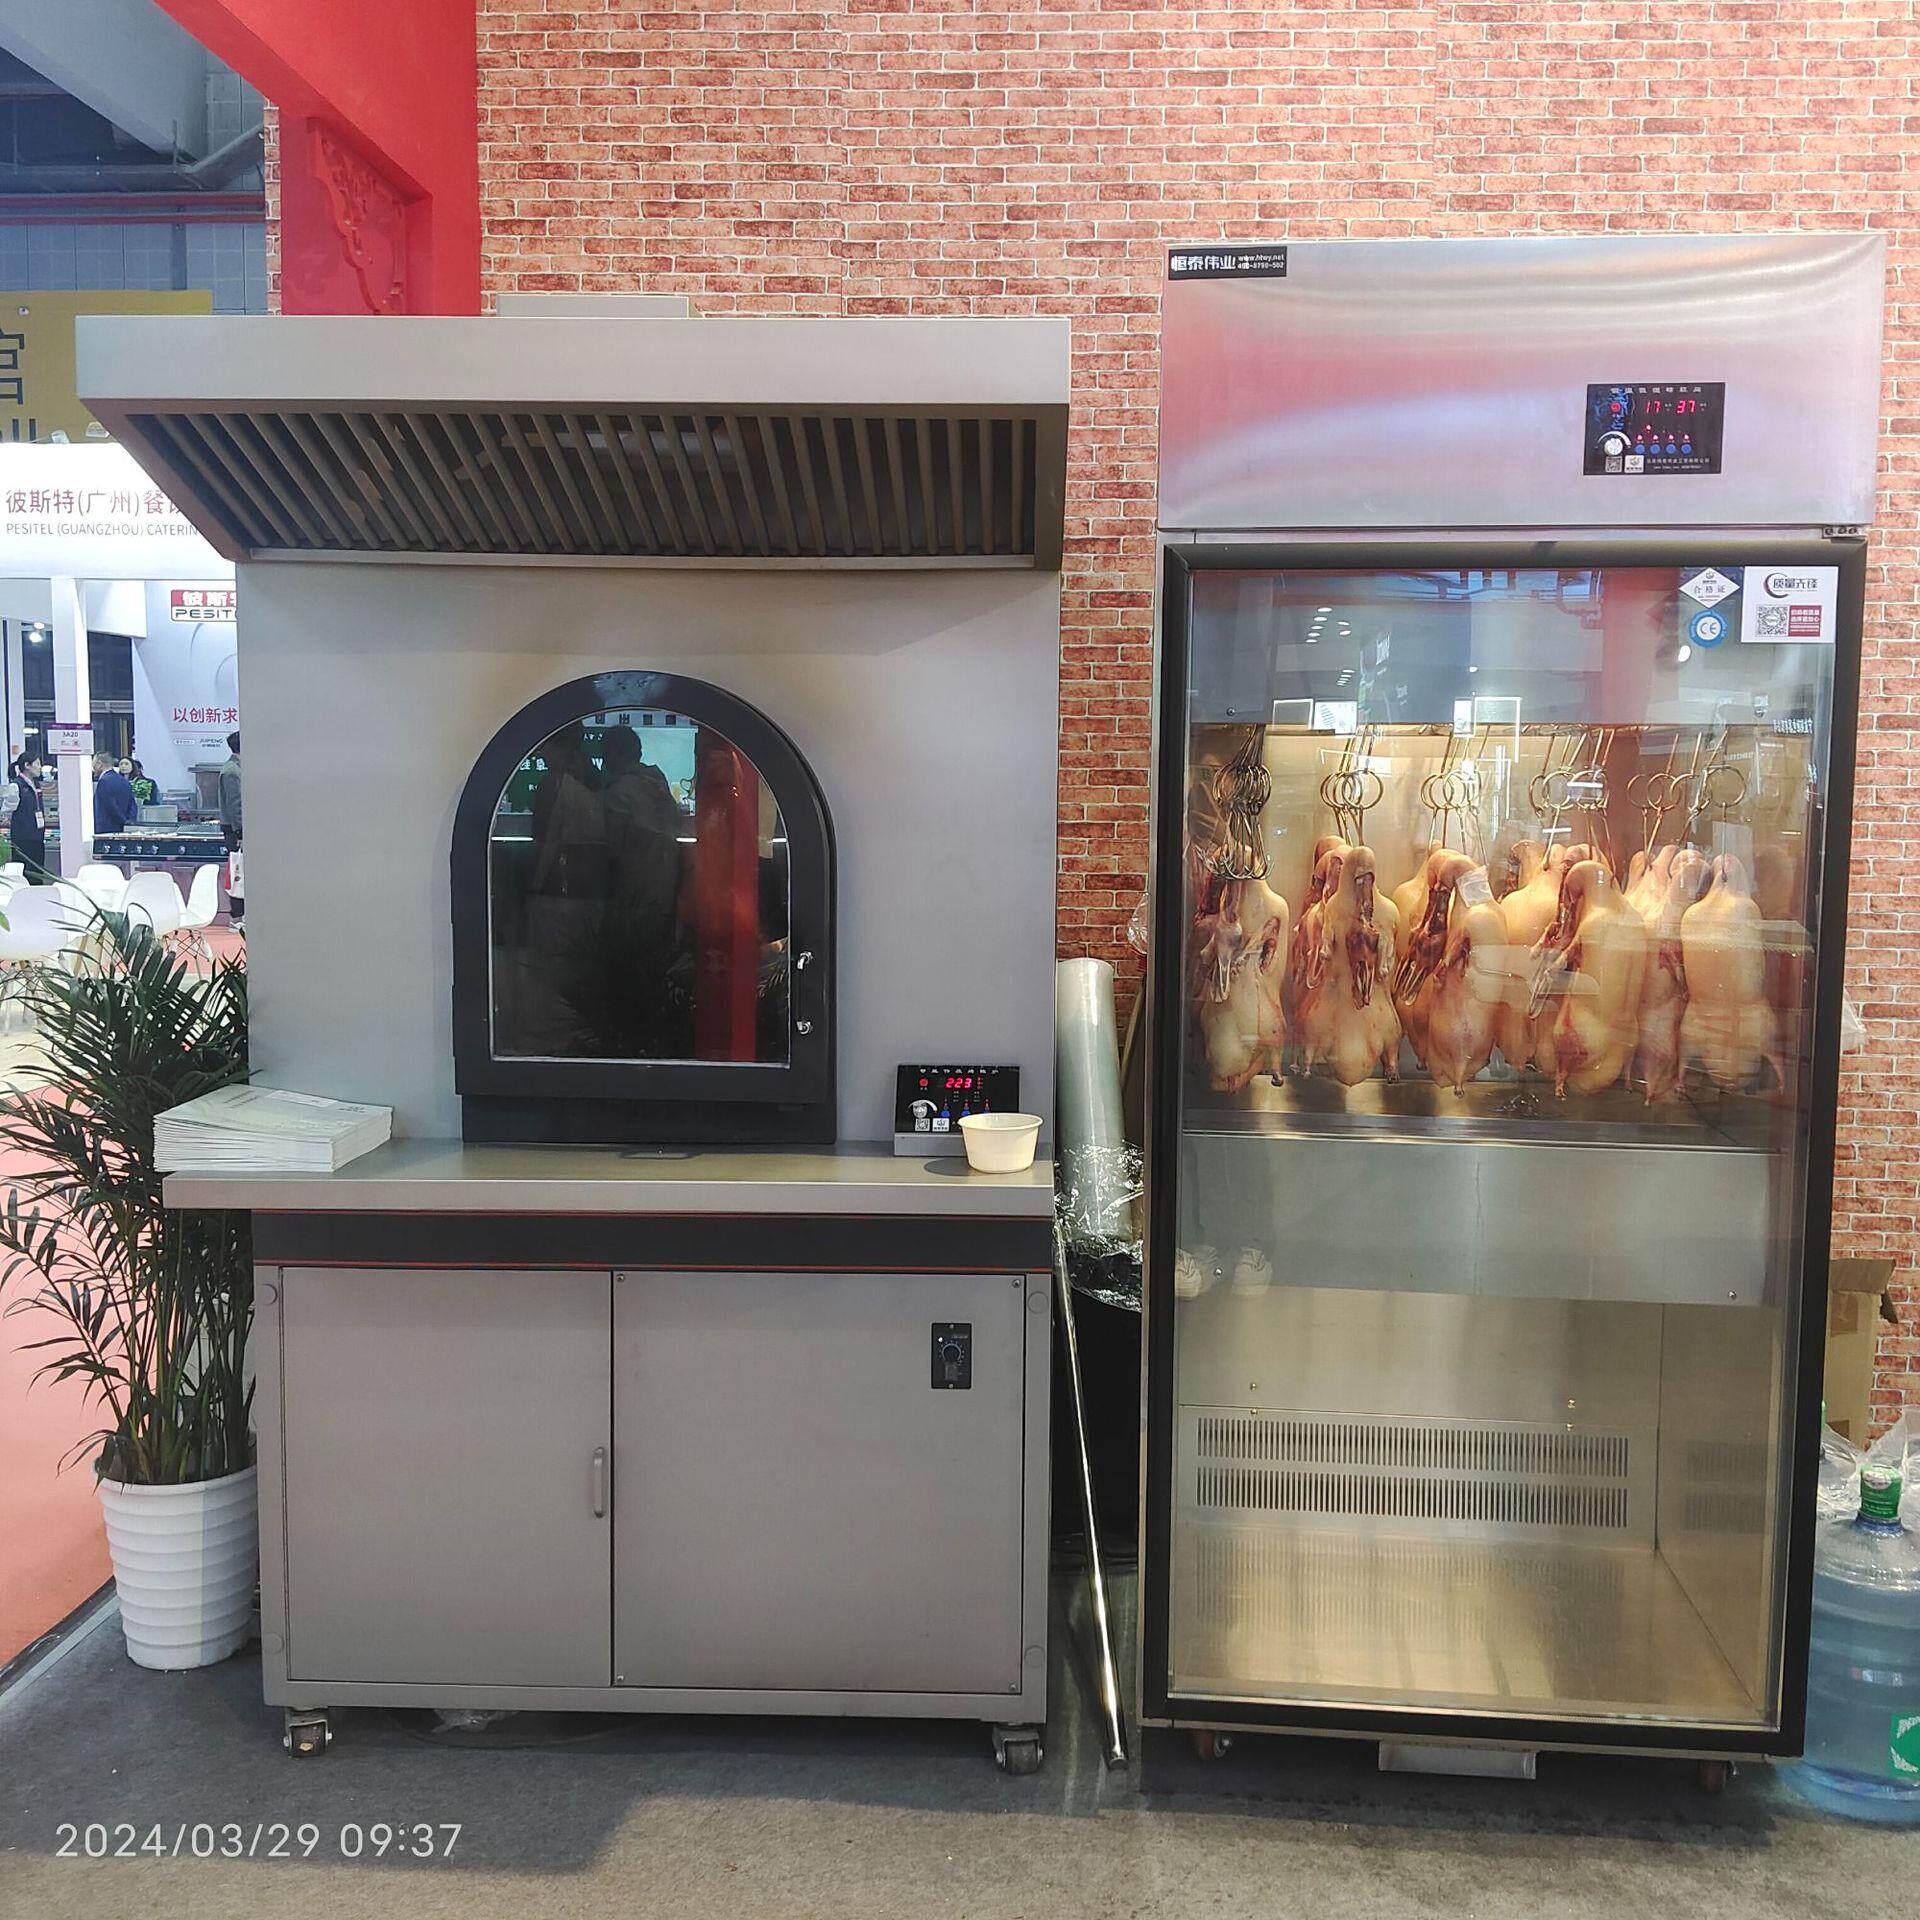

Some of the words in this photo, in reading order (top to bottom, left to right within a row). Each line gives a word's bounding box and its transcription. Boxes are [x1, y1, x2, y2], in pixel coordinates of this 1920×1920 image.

[1170, 255, 1236, 271] 恒泰伟业
[1646, 400, 1661, 414] 17
[1677, 400, 1696, 414] 37
[6, 489, 182, 516] 彼斯特(广州)餐
[6, 523, 54, 536] PESITEL
[57, 523, 144, 537] (GUANGZHOU)
[175, 609, 237, 618] PESIT
[1700, 622, 1717, 635] CE
[173, 707, 238, 724] 以创新求
[946, 1078, 972, 1088] 223
